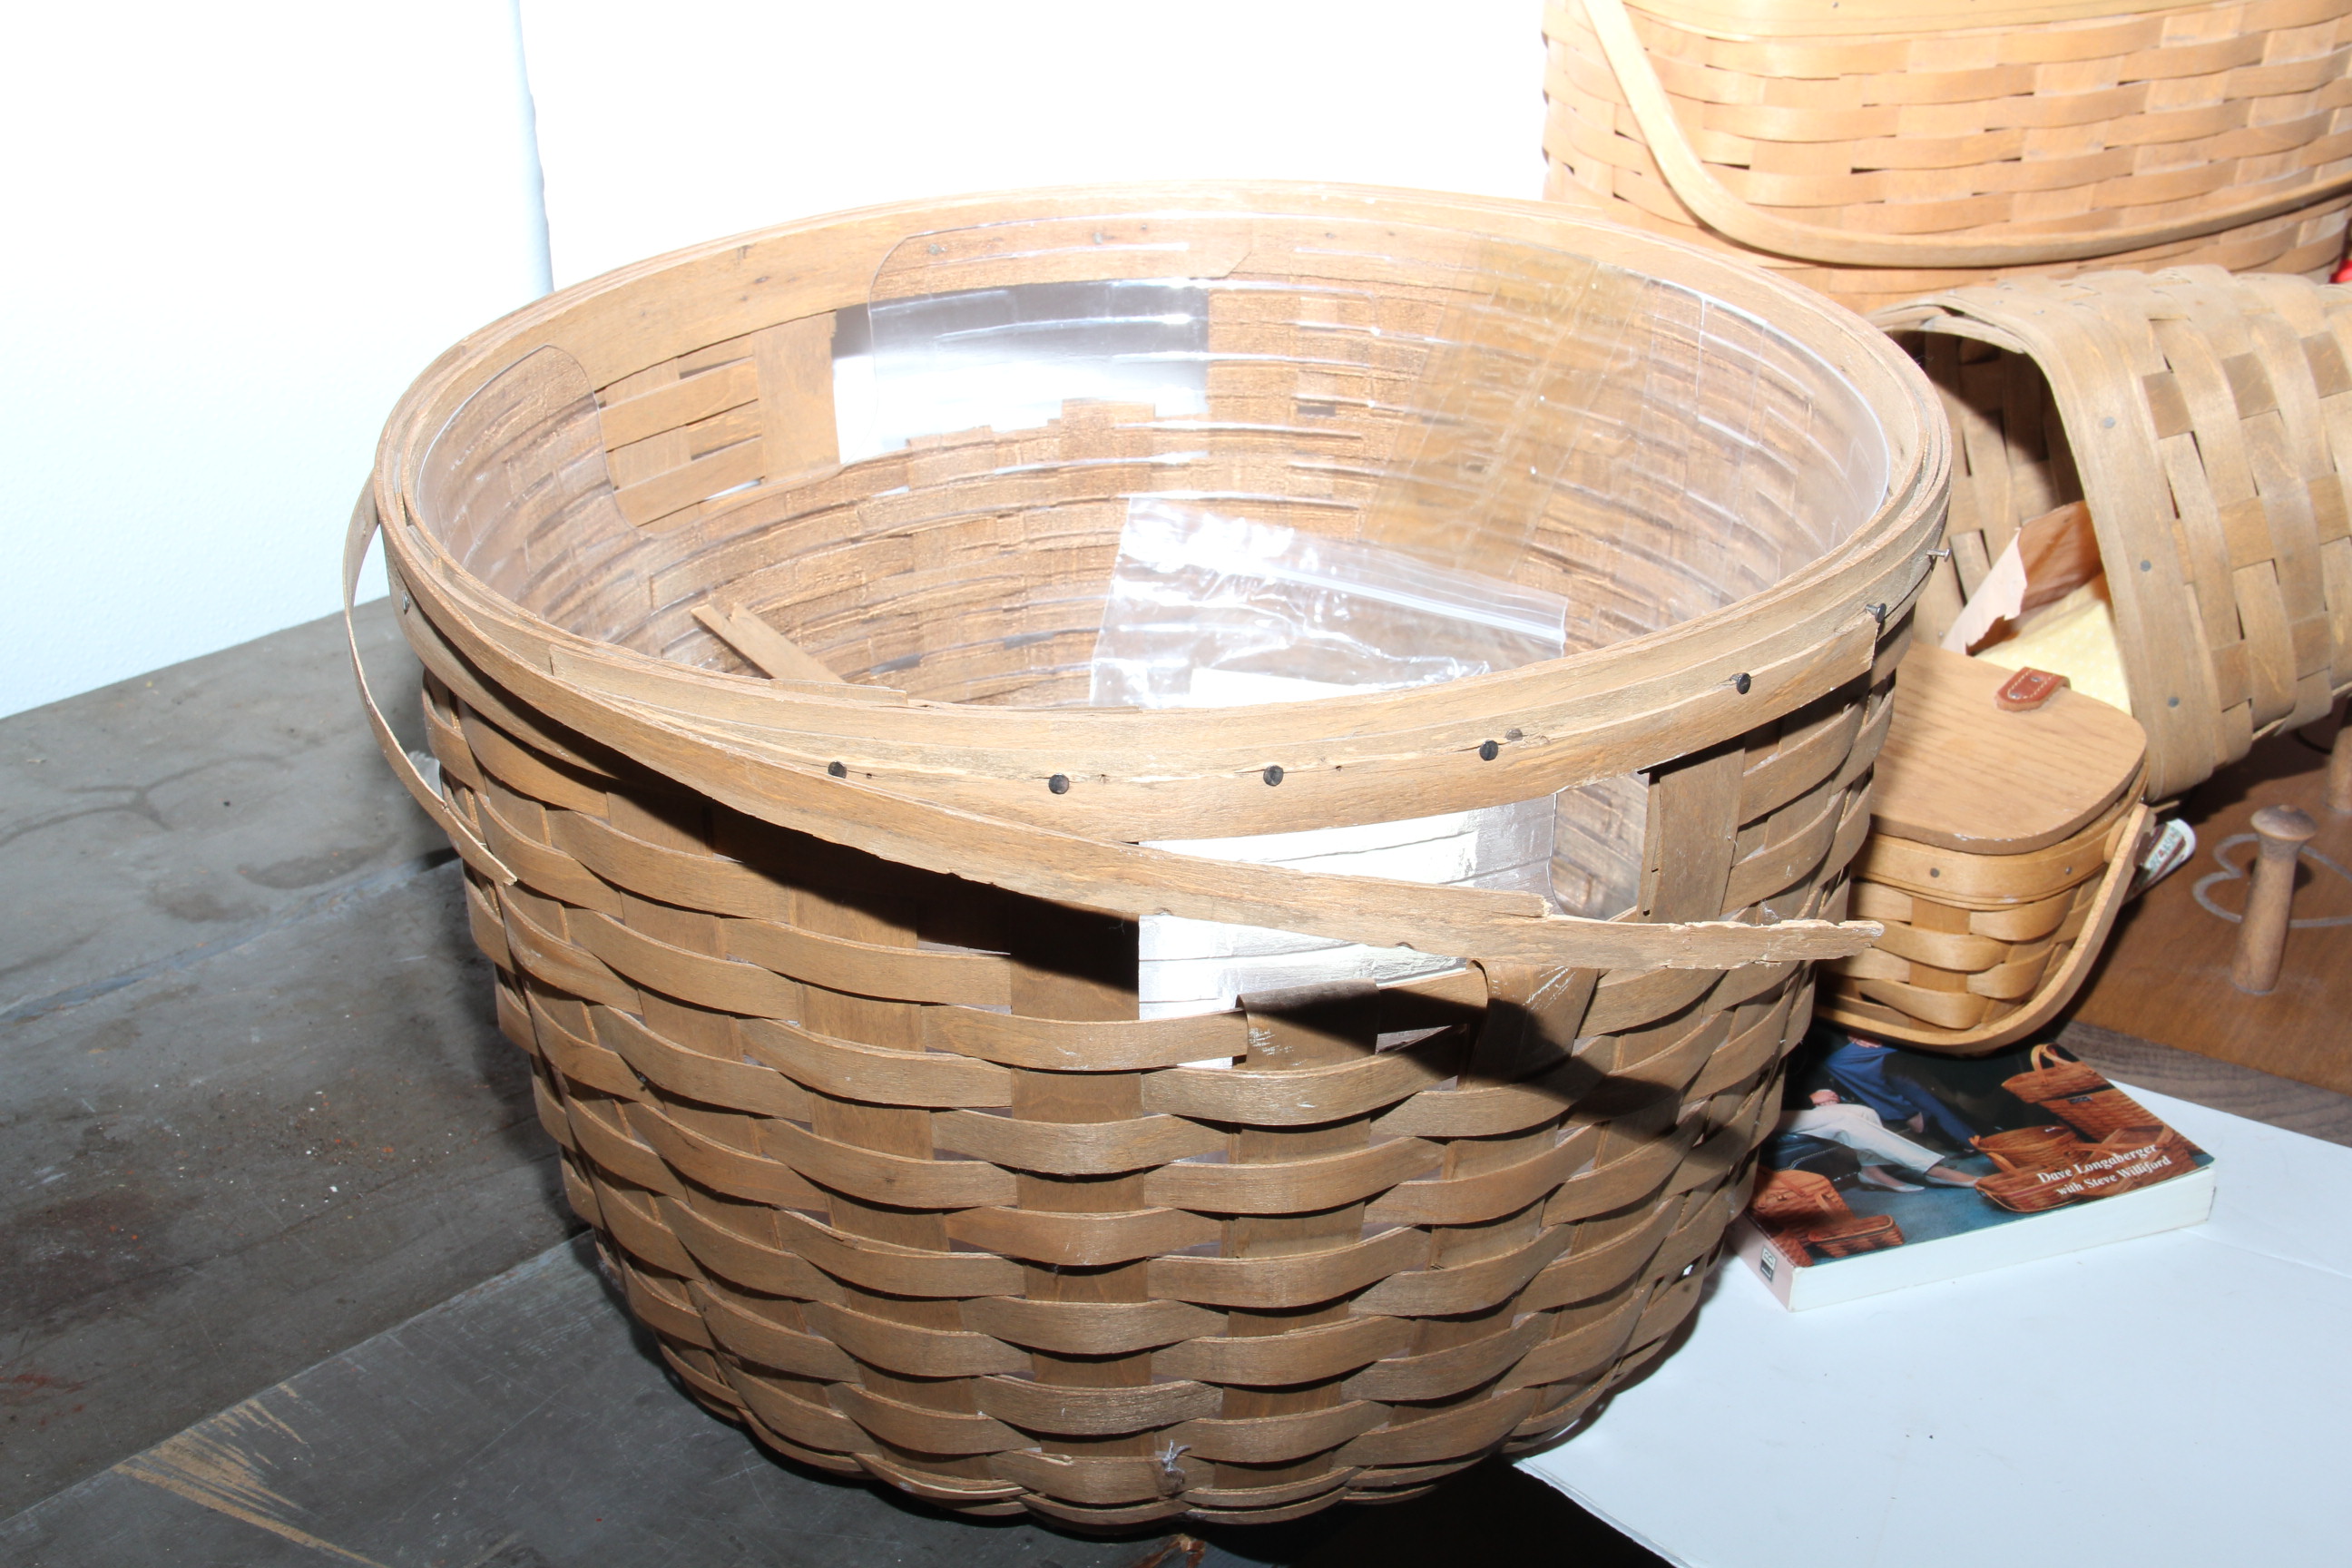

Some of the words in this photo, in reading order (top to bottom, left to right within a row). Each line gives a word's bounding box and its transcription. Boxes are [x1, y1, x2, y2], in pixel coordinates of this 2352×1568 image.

[2036, 1168, 2073, 1183] Dave
[2073, 1143, 2158, 1175] Longaberger
[2056, 1181, 2084, 1196] with
[2083, 1173, 2118, 1189] Steve
[2115, 1154, 2172, 1179] Williford
